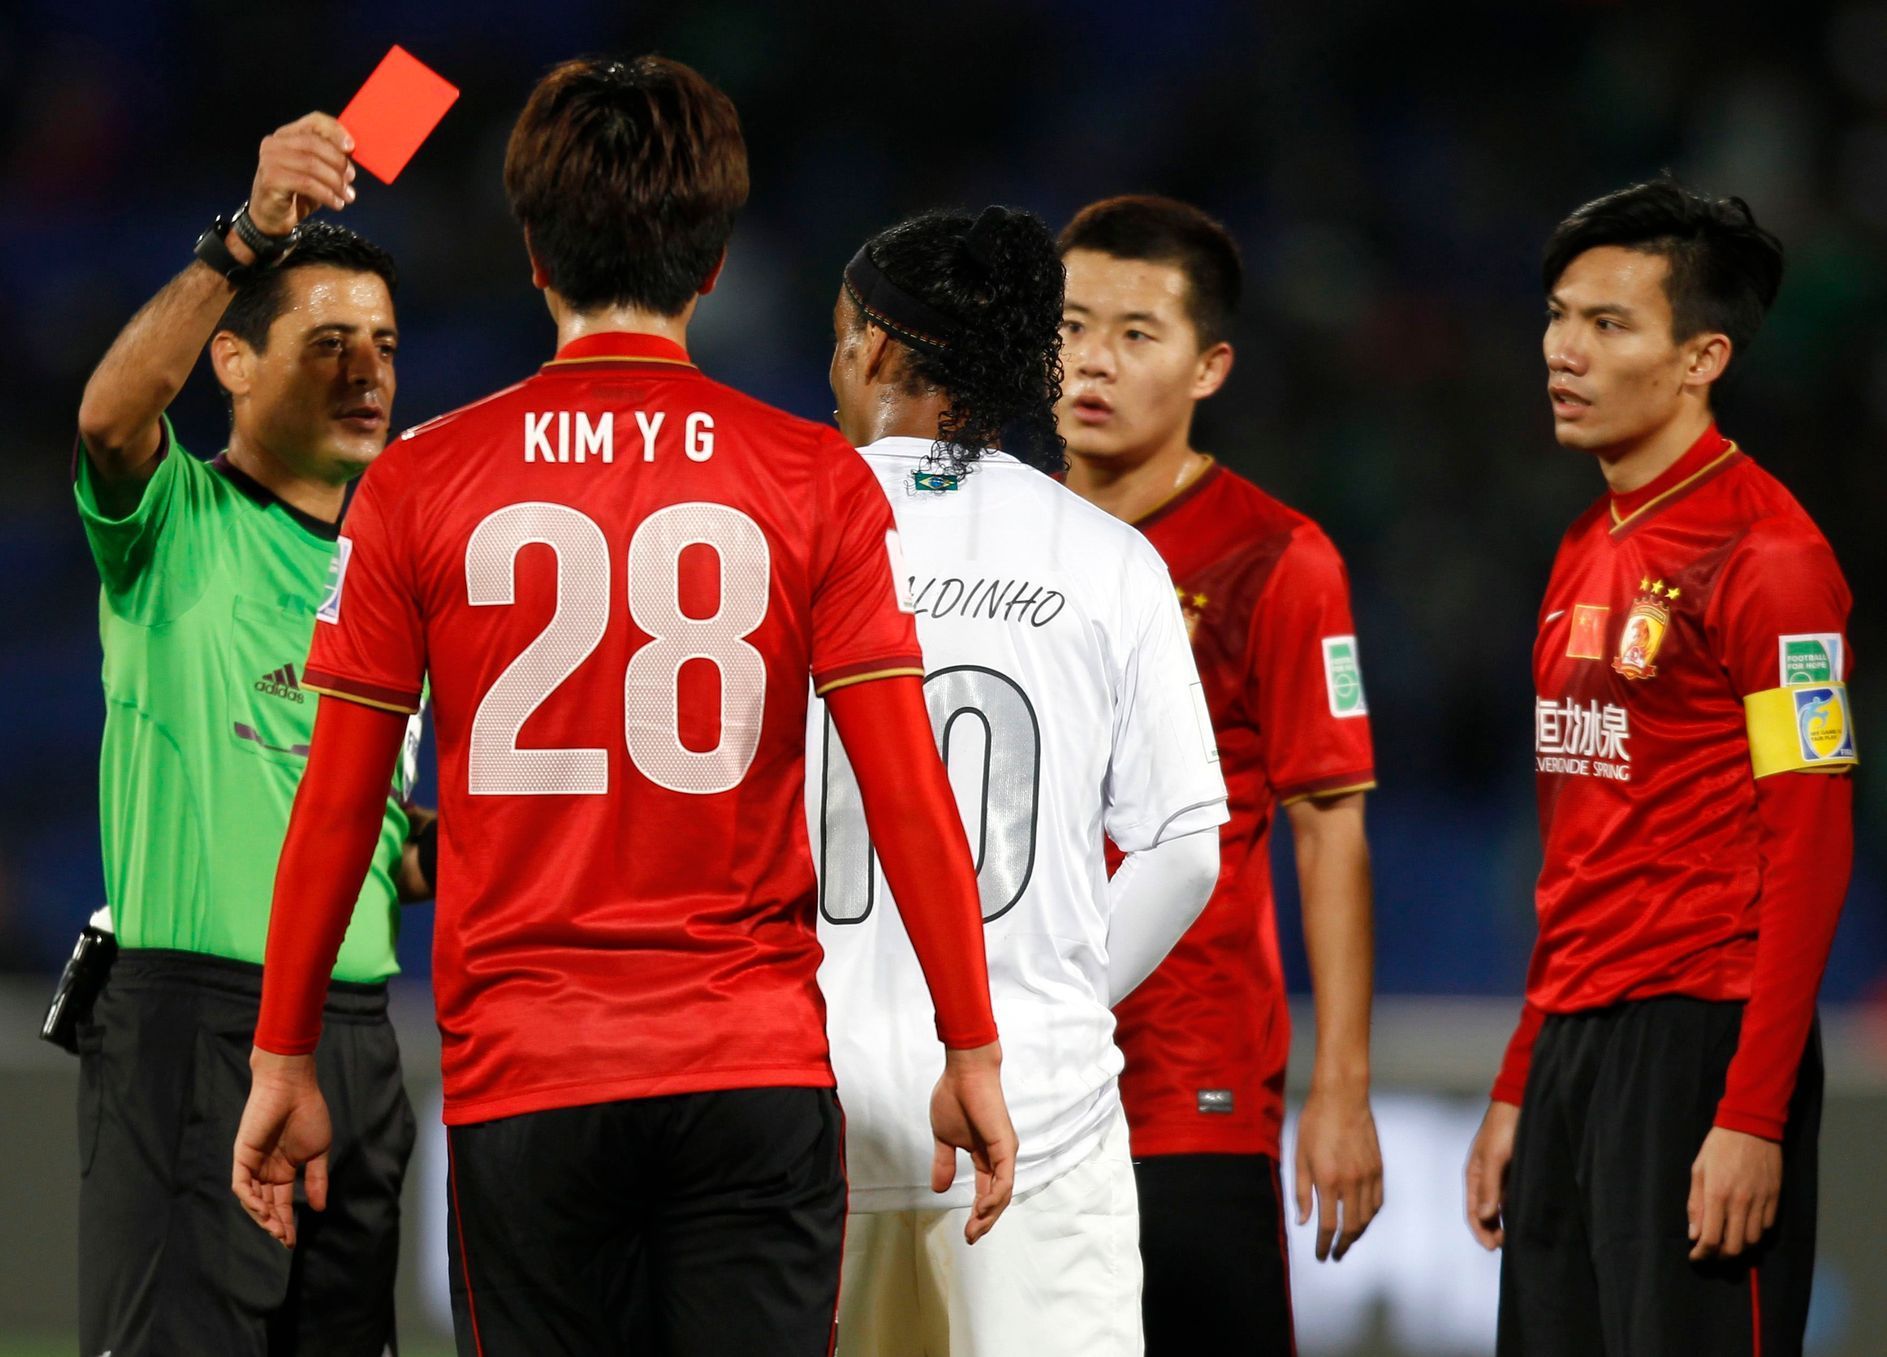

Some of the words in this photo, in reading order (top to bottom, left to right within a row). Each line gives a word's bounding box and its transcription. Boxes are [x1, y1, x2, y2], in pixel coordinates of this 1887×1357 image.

[524, 411, 613, 463] KIM
[635, 411, 665, 462] Y
[685, 411, 715, 462] G
[465, 501, 770, 796] 28
[254, 680, 305, 704] adidas
